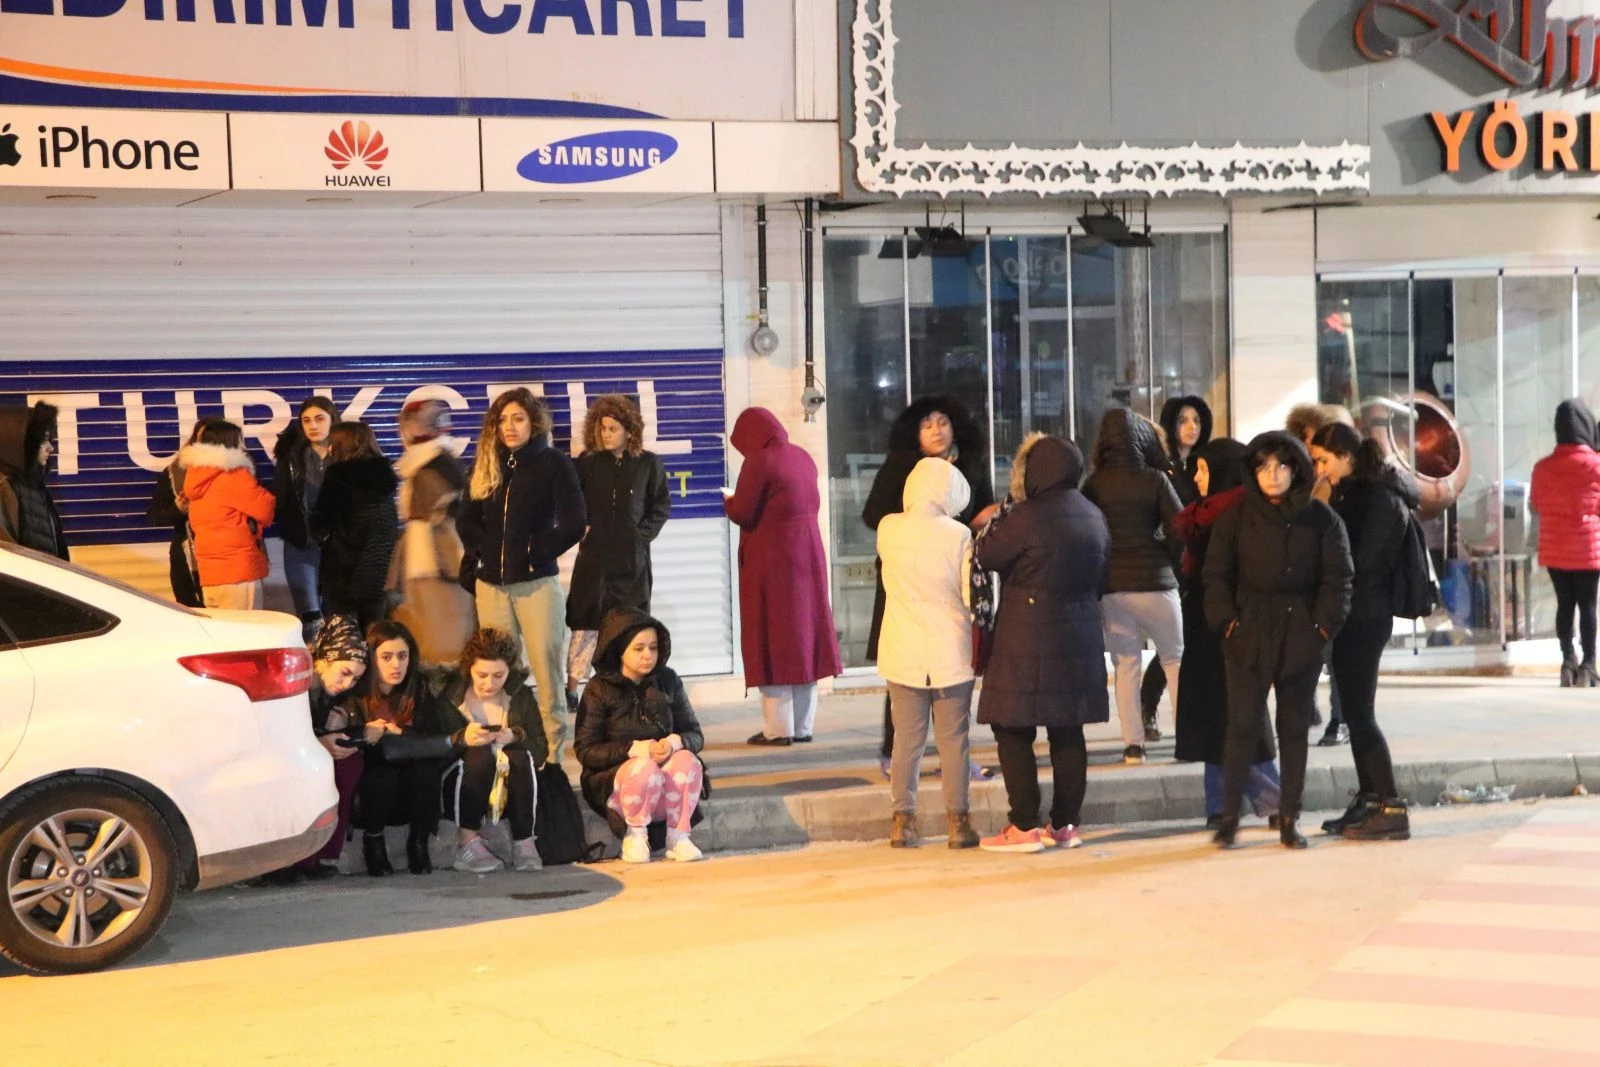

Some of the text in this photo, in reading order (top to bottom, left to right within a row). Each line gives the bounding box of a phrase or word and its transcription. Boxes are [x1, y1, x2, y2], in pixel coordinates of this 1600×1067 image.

[38, 125, 199, 170] iPhone
[538, 145, 661, 168] SAMSUNG
[325, 175, 391, 187] HUAWEI
[27, 380, 692, 475] TURCLL
